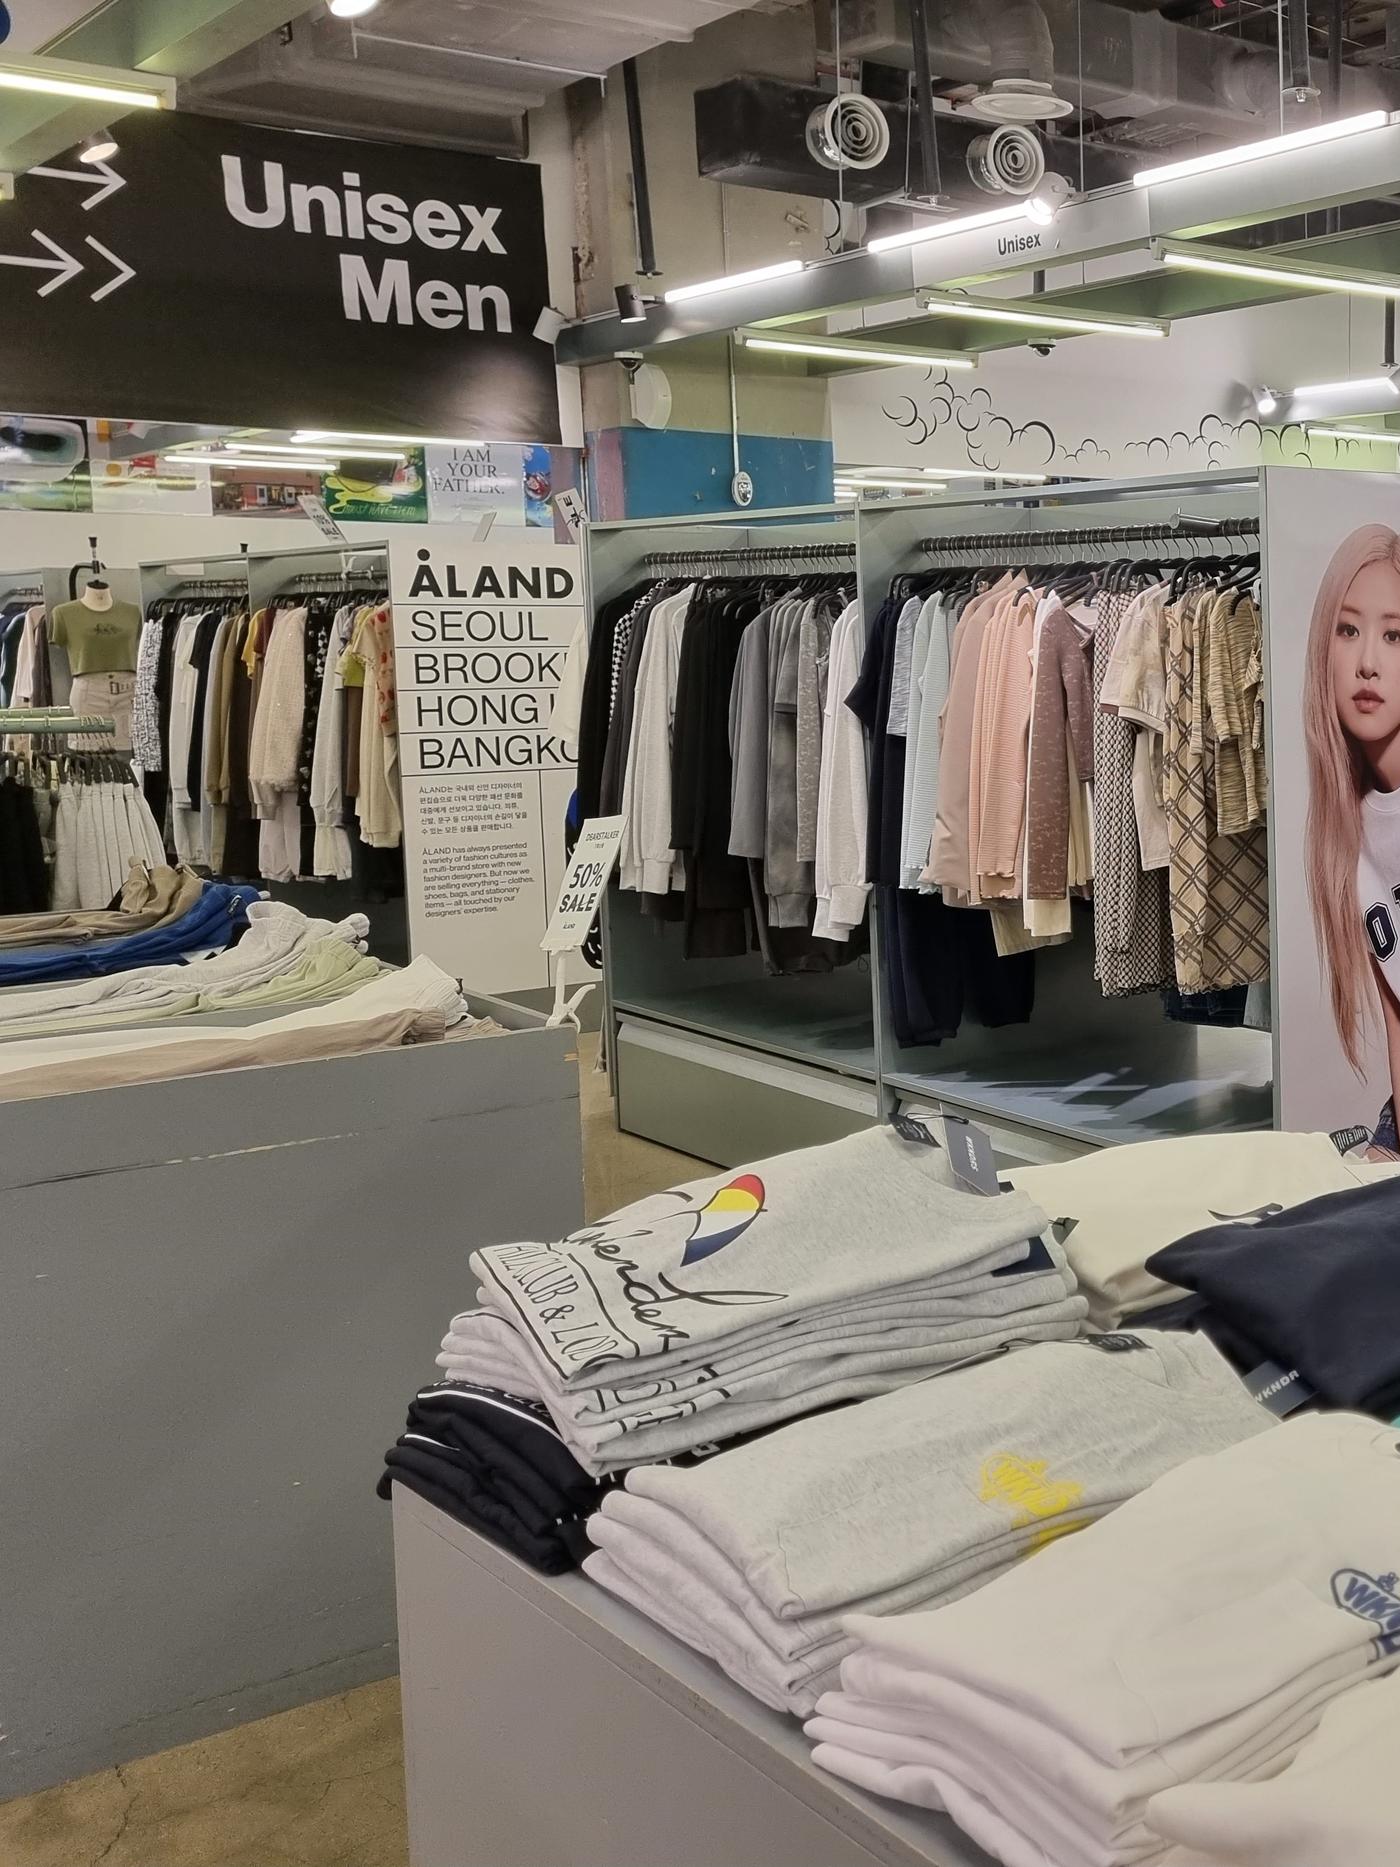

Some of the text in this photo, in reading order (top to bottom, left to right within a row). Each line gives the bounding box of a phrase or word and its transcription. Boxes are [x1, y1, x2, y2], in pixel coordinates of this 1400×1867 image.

[221, 155, 507, 255] Unisex
[998, 232, 1042, 256] Unisex
[339, 254, 512, 333] Men
[453, 448, 491, 462] I AM
[447, 463, 497, 478] YOUR
[408, 548, 574, 599] ÅLAND
[411, 610, 549, 642] SEOUL
[414, 652, 566, 685] BROOK
[416, 693, 539, 727] HONG
[492, 842, 527, 851] presented
[438, 882, 460, 890] selling
[462, 879, 499, 889] everything
[569, 862, 606, 888] 50%
[463, 897, 493, 905] touched
[559, 892, 597, 913] SALE
[538, 1303, 575, 1325] &
[1254, 1369, 1300, 1402] WKNDR
